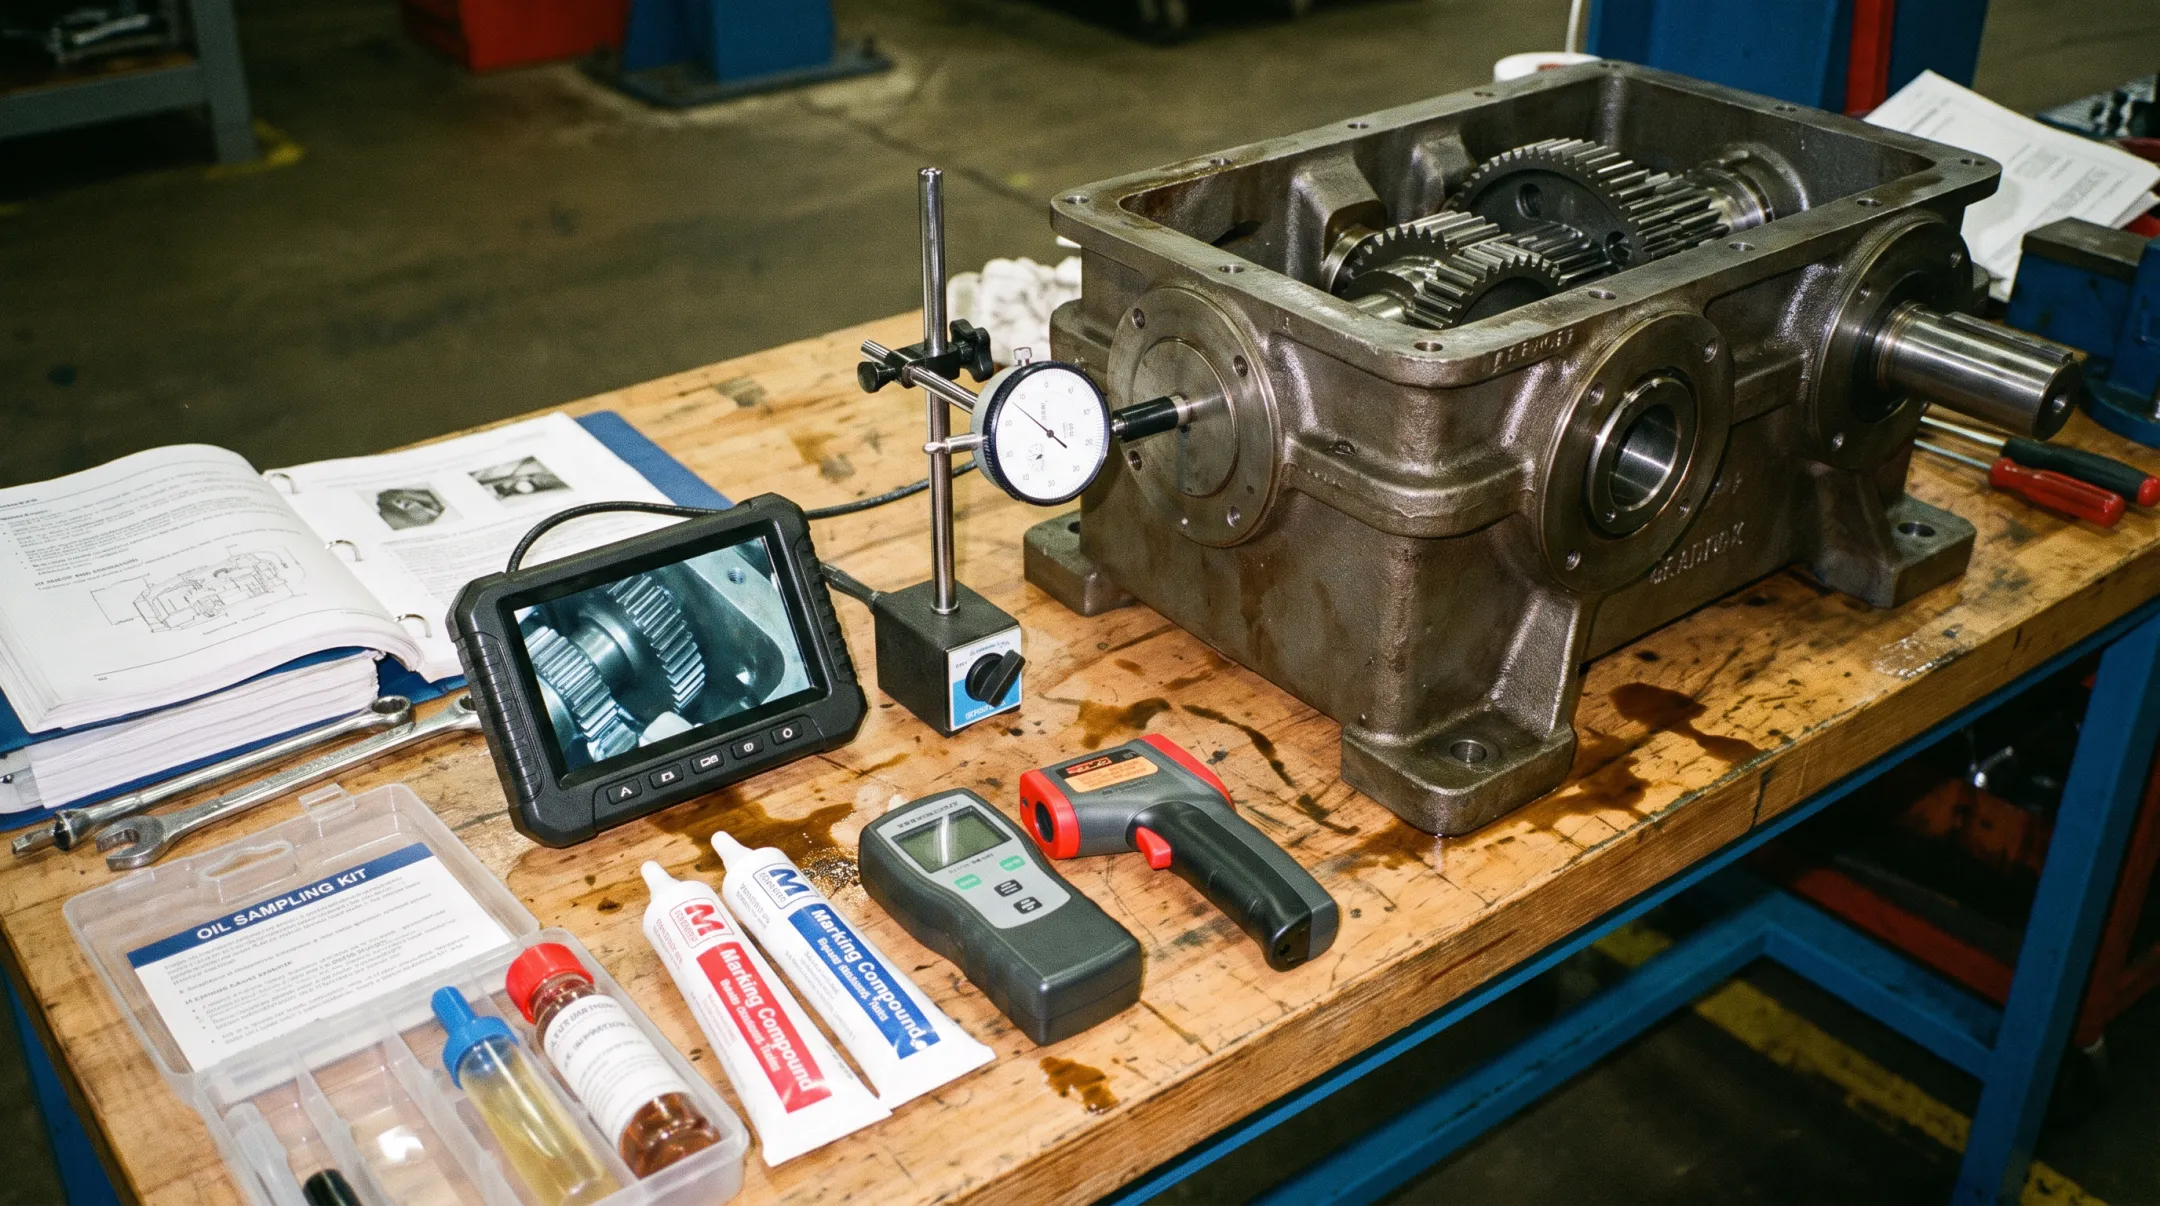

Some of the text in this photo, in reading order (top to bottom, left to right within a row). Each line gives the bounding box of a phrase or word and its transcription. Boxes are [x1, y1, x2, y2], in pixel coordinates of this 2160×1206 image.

[197, 868, 368, 939] OIL SAMPLING KIT
[768, 868, 810, 897] M
[685, 903, 725, 937] M
[811, 909, 862, 963] Marking
[857, 962, 928, 1039] Compound
[720, 948, 764, 1009] Marking
[757, 1007, 819, 1092] Compound
